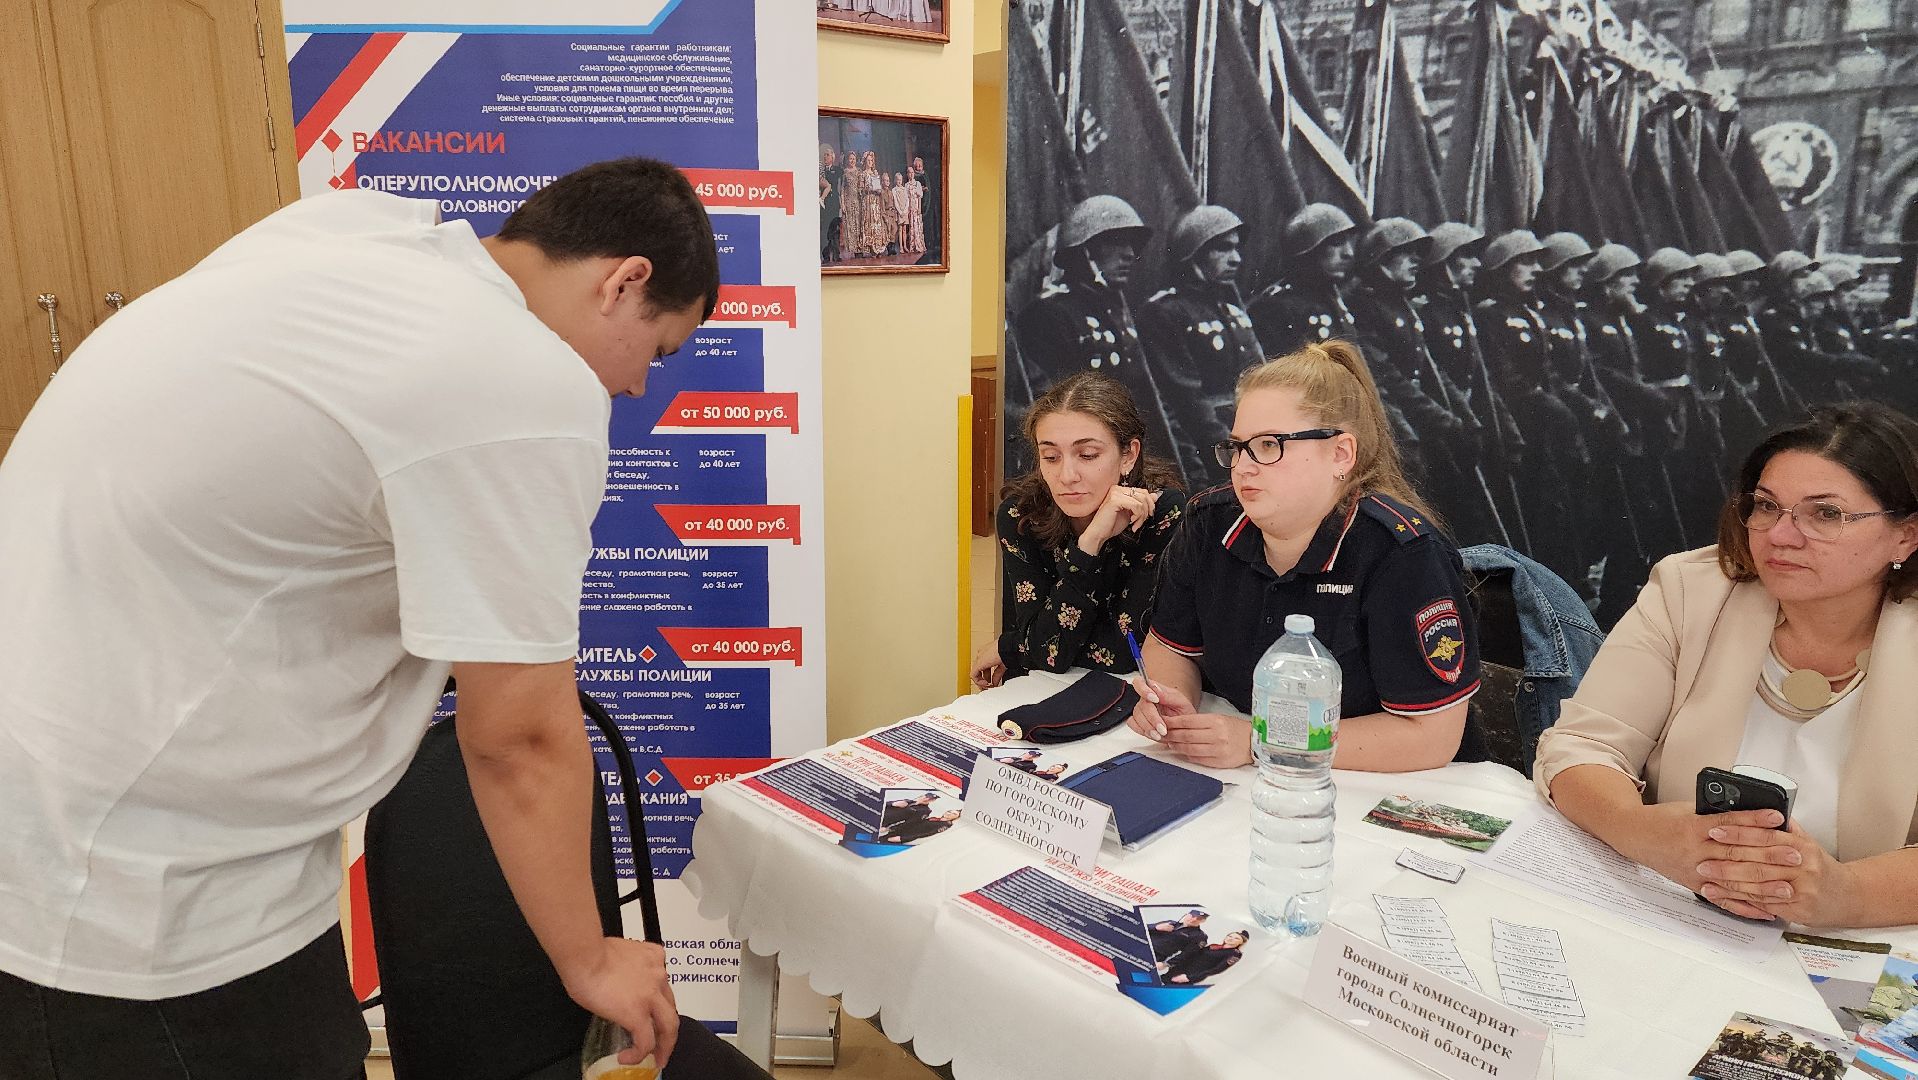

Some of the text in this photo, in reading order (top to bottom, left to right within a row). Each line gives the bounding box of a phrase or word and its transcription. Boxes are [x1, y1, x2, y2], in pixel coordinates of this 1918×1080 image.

[571, 43, 732, 53] Социальные гарантии работникам:
[608, 54, 732, 63] медицинское обслуживание,
[580, 64, 733, 73] санаторно-курортное обеспечение,
[501, 74, 733, 83] обеспечение детскими дошкольными учреждениями,
[535, 85, 569, 93] условия
[572, 85, 587, 93] для
[589, 85, 622, 93] приема
[624, 85, 646, 93] пищи
[690, 86, 733, 94] перерыва
[497, 94, 520, 102] Иные
[561, 95, 613, 103] социальные
[658, 95, 693, 103] пособия
[704, 96, 733, 104] другие
[482, 105, 525, 113] денежные
[569, 105, 626, 114] сотрудникам
[628, 106, 661, 114] органов
[664, 105, 713, 114] внутренних
[537, 115, 583, 123] страховых
[679, 116, 734, 124] обеспечение
[352, 131, 505, 154] ВАКАНСИИ
[358, 175, 558, 192] ОПЕРУПОЛНОМОЧЕ
[695, 183, 782, 200] 45 000 руб.
[721, 302, 784, 316] 000 руб.
[695, 337, 732, 345] возраст
[695, 349, 707, 357] до
[681, 406, 787, 422] от 50 000 руб.
[608, 448, 663, 456] пособность
[699, 449, 735, 457] возраст
[699, 461, 711, 469] до
[614, 471, 649, 480] беседу,
[685, 518, 789, 533] от 40 000 руб.
[635, 548, 708, 561] ПОЛИЦИИ
[583, 570, 614, 578] еседу,
[668, 570, 691, 578] речь,
[703, 570, 738, 578] возраст
[703, 581, 714, 589] до
[716, 581, 725, 589] 35
[611, 592, 670, 600] конфликтных
[645, 603, 686, 611] работать
[1419, 603, 1453, 623] ПОЛИЦИЯ
[1424, 619, 1457, 642] РОССИЯ
[692, 641, 795, 655] от 40 000 руб.
[639, 670, 712, 683] ПОЛИЦИИ
[671, 691, 694, 699] речь,
[705, 691, 740, 699] возраст
[706, 702, 717, 710] до
[719, 702, 729, 710] 35
[616, 713, 673, 721] конфликтных
[648, 723, 688, 732] работать
[694, 775, 711, 784] от
[998, 766, 1085, 810] ОМВД РОССИИ
[984, 778, 1089, 829] ПО ГОРОДСКОМУ
[1006, 807, 1055, 835] ОКРУГУ
[974, 810, 1081, 867] СОЛНЕЧНОГОРСК
[667, 974, 740, 984] ержинског
[1343, 944, 1519, 1039] Военный комиссариат
[1337, 967, 1512, 1060] города Солнечногорск
[1337, 986, 1498, 1076] Московской области
